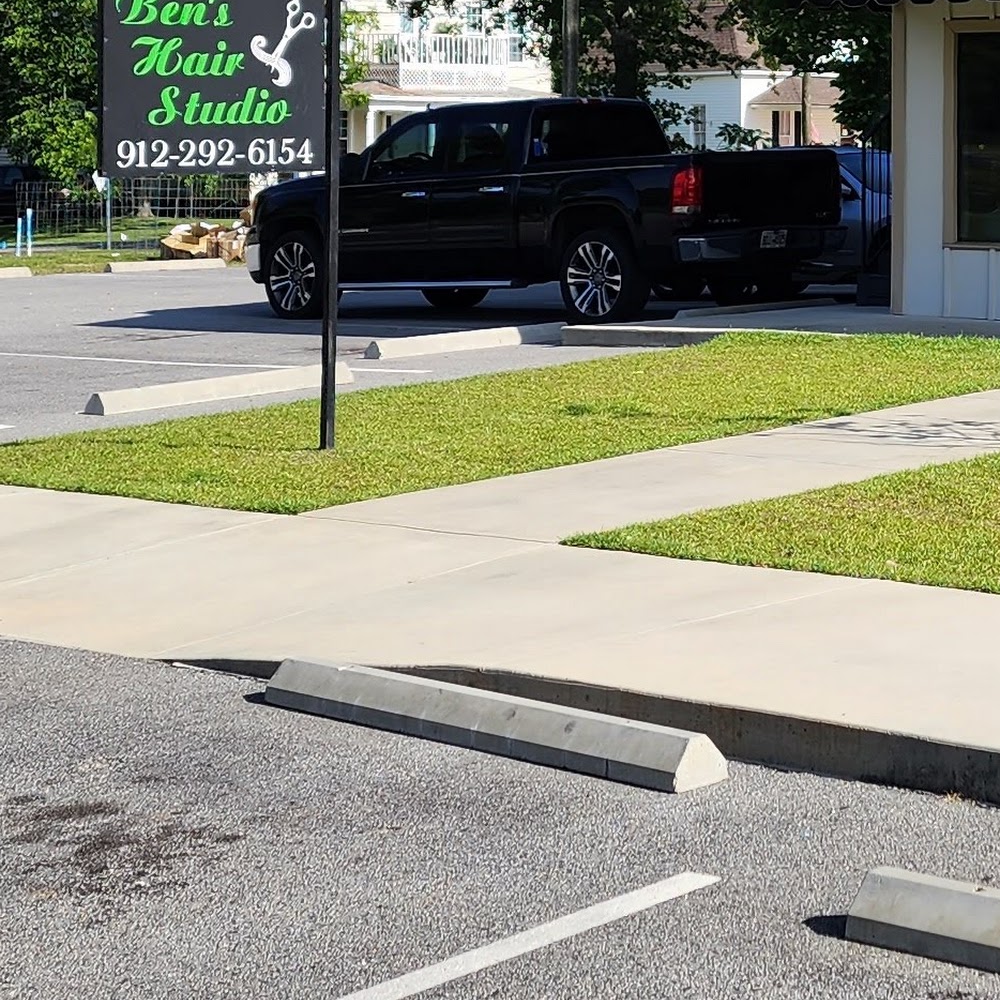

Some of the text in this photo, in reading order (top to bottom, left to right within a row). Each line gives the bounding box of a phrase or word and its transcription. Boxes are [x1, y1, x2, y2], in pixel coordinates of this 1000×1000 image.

[130, 36, 245, 77] Hair
[148, 85, 292, 126] Studio
[116, 138, 313, 168] 912-292-6154
